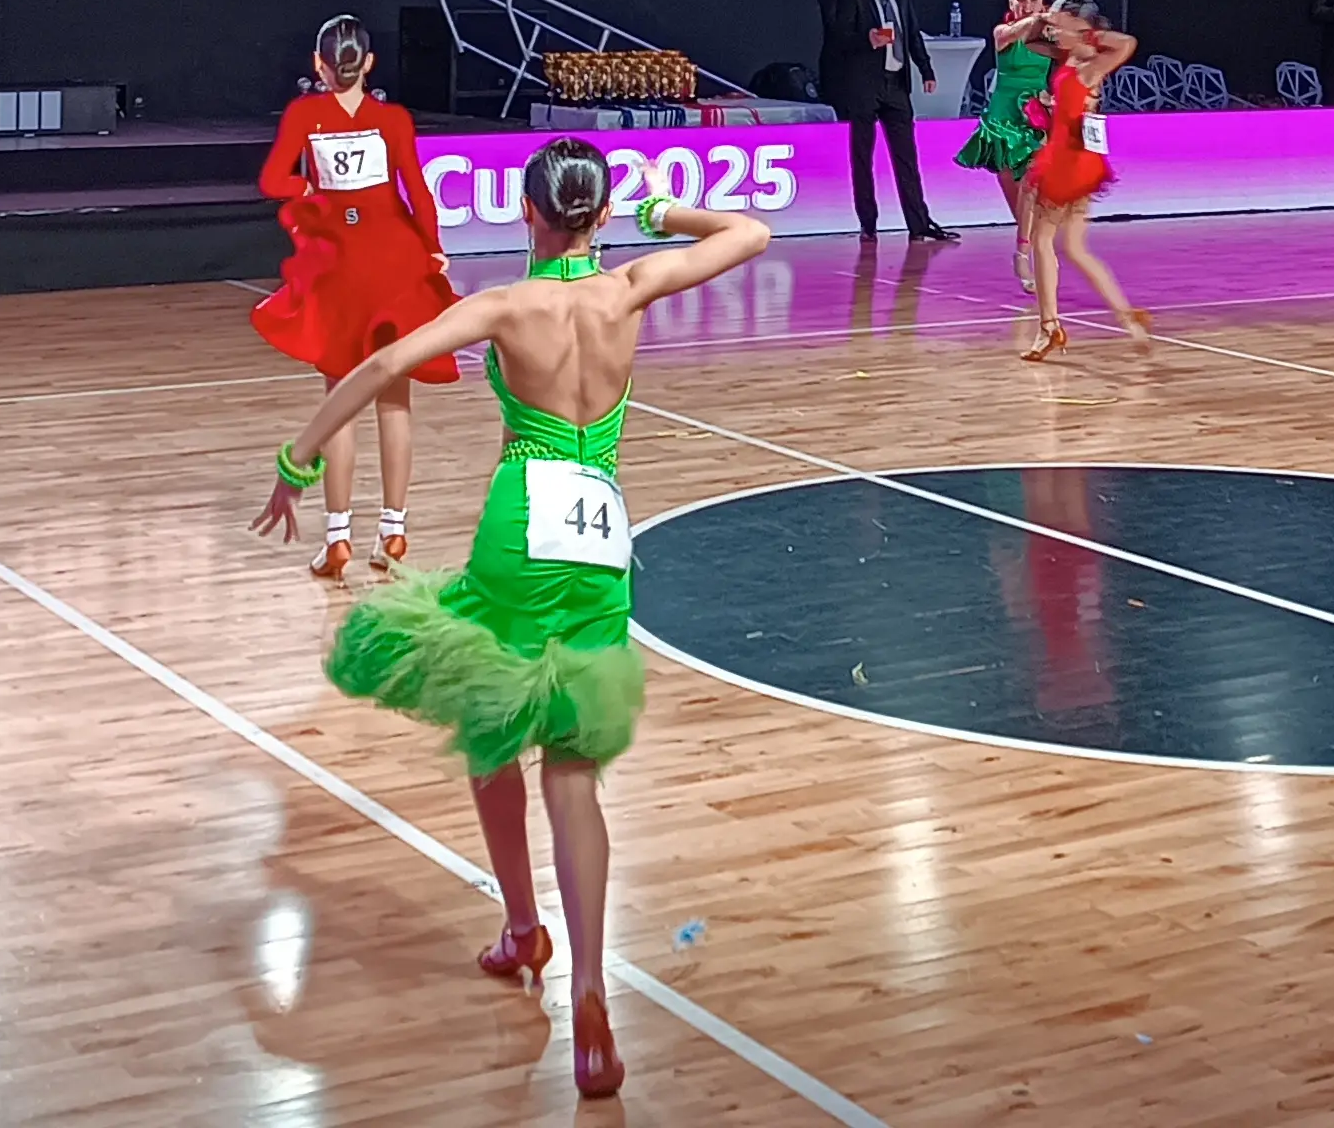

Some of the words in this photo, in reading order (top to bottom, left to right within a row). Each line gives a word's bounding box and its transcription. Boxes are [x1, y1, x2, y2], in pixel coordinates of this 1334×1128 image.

[333, 149, 366, 176] 87
[421, 154, 527, 228] Cu
[605, 144, 799, 218] 2025
[564, 497, 612, 540] 44
